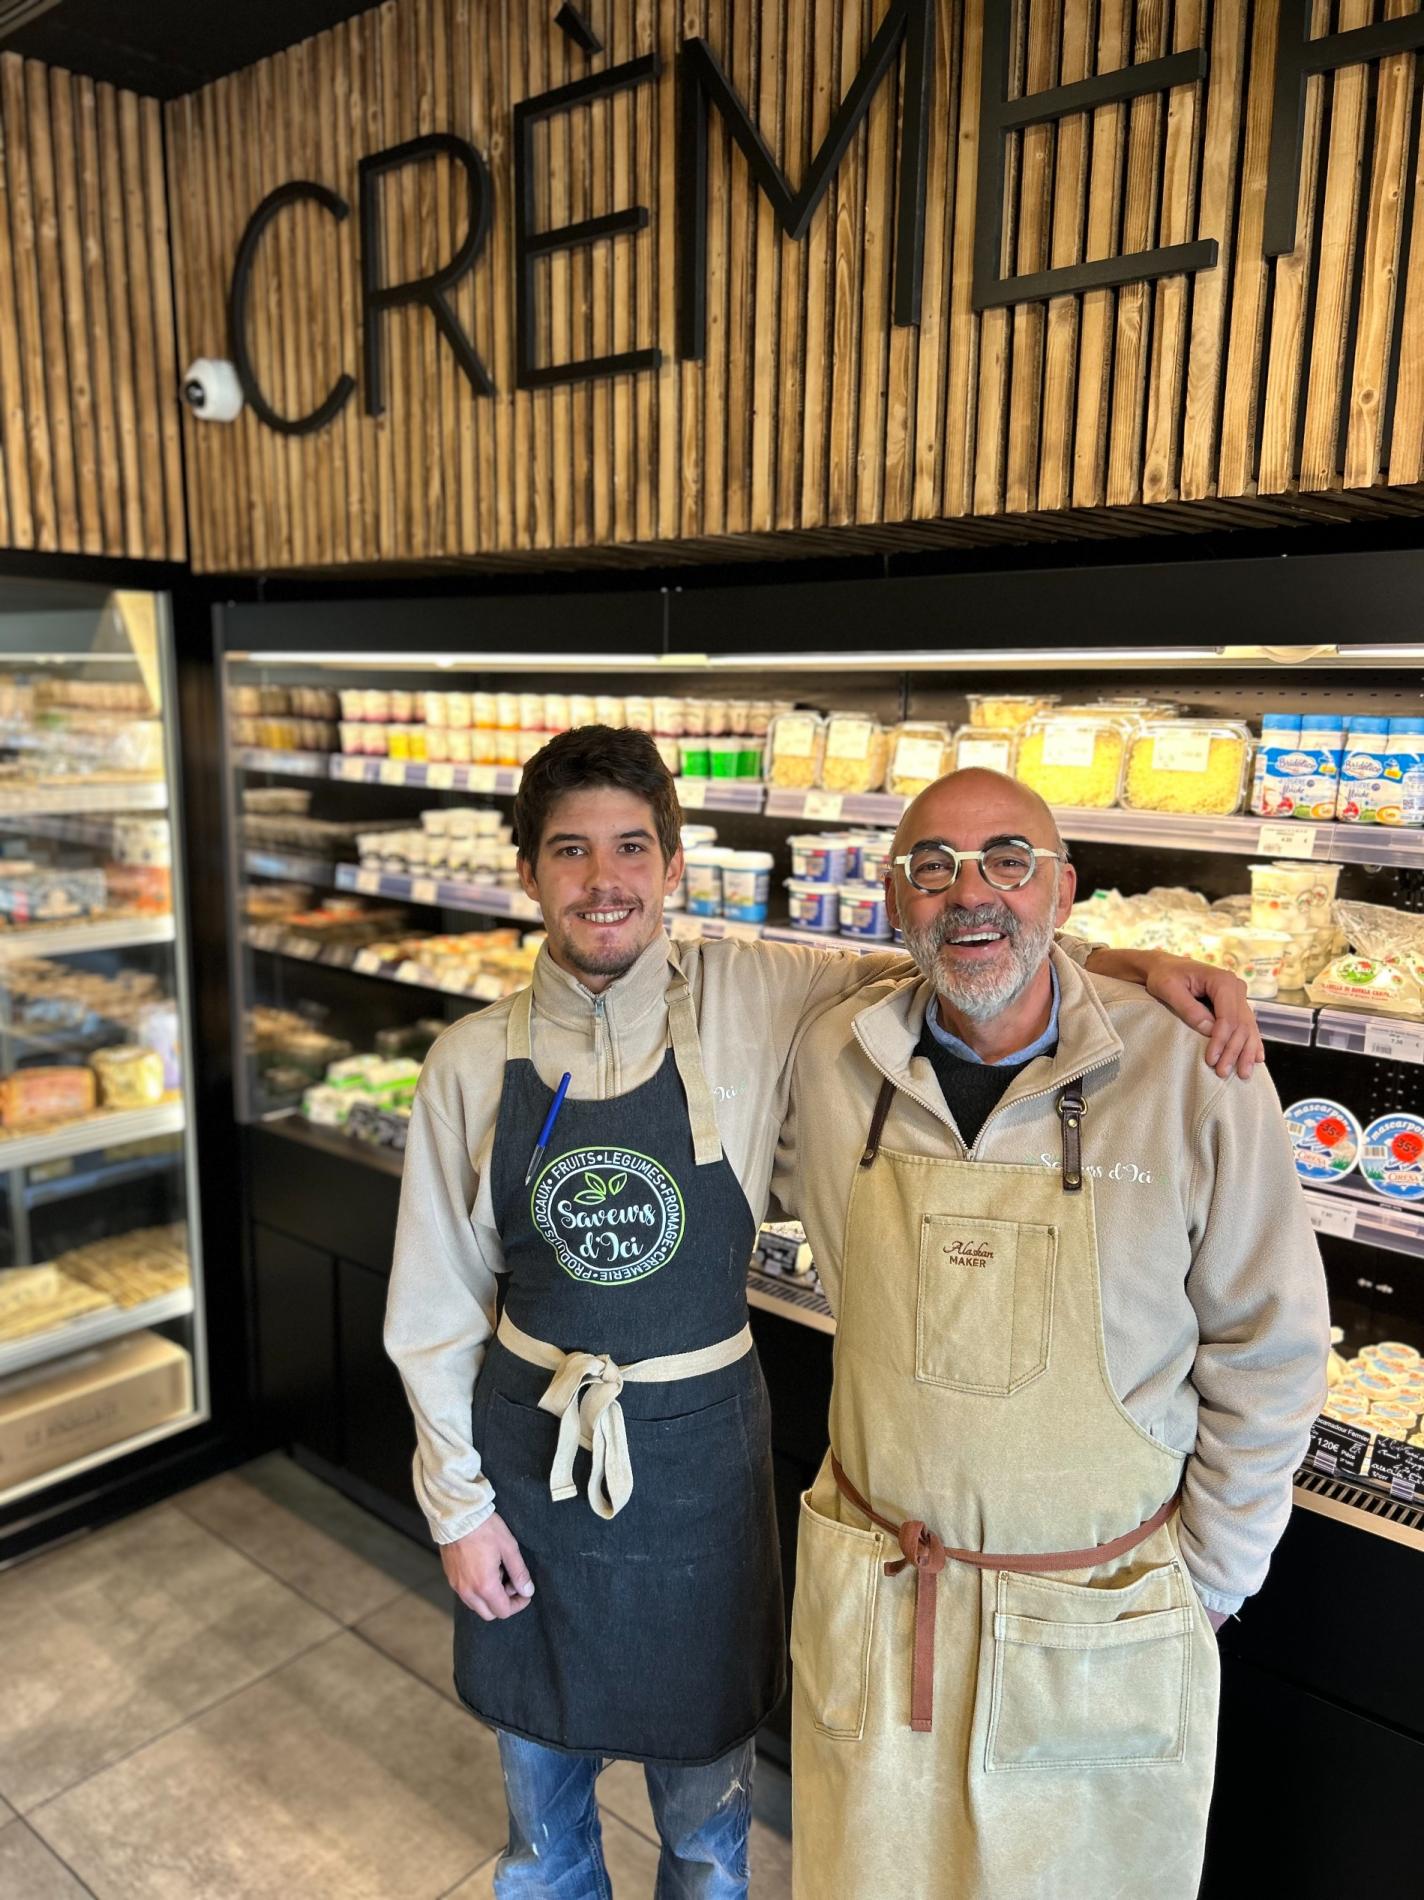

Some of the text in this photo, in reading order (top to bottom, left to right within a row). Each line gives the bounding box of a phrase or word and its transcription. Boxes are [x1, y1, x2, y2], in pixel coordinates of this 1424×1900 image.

[535, 1151, 680, 1281] FRUITS LEGUMES FROMAGE CREMERIE PRODUITS LOCAUX
[557, 1199, 656, 1229] Saveurs
[579, 1231, 644, 1262] d'Ici
[943, 1240, 994, 1259] Alaskan
[949, 1255, 986, 1268] MAKER
[1347, 1429, 1370, 1442] Fermier
